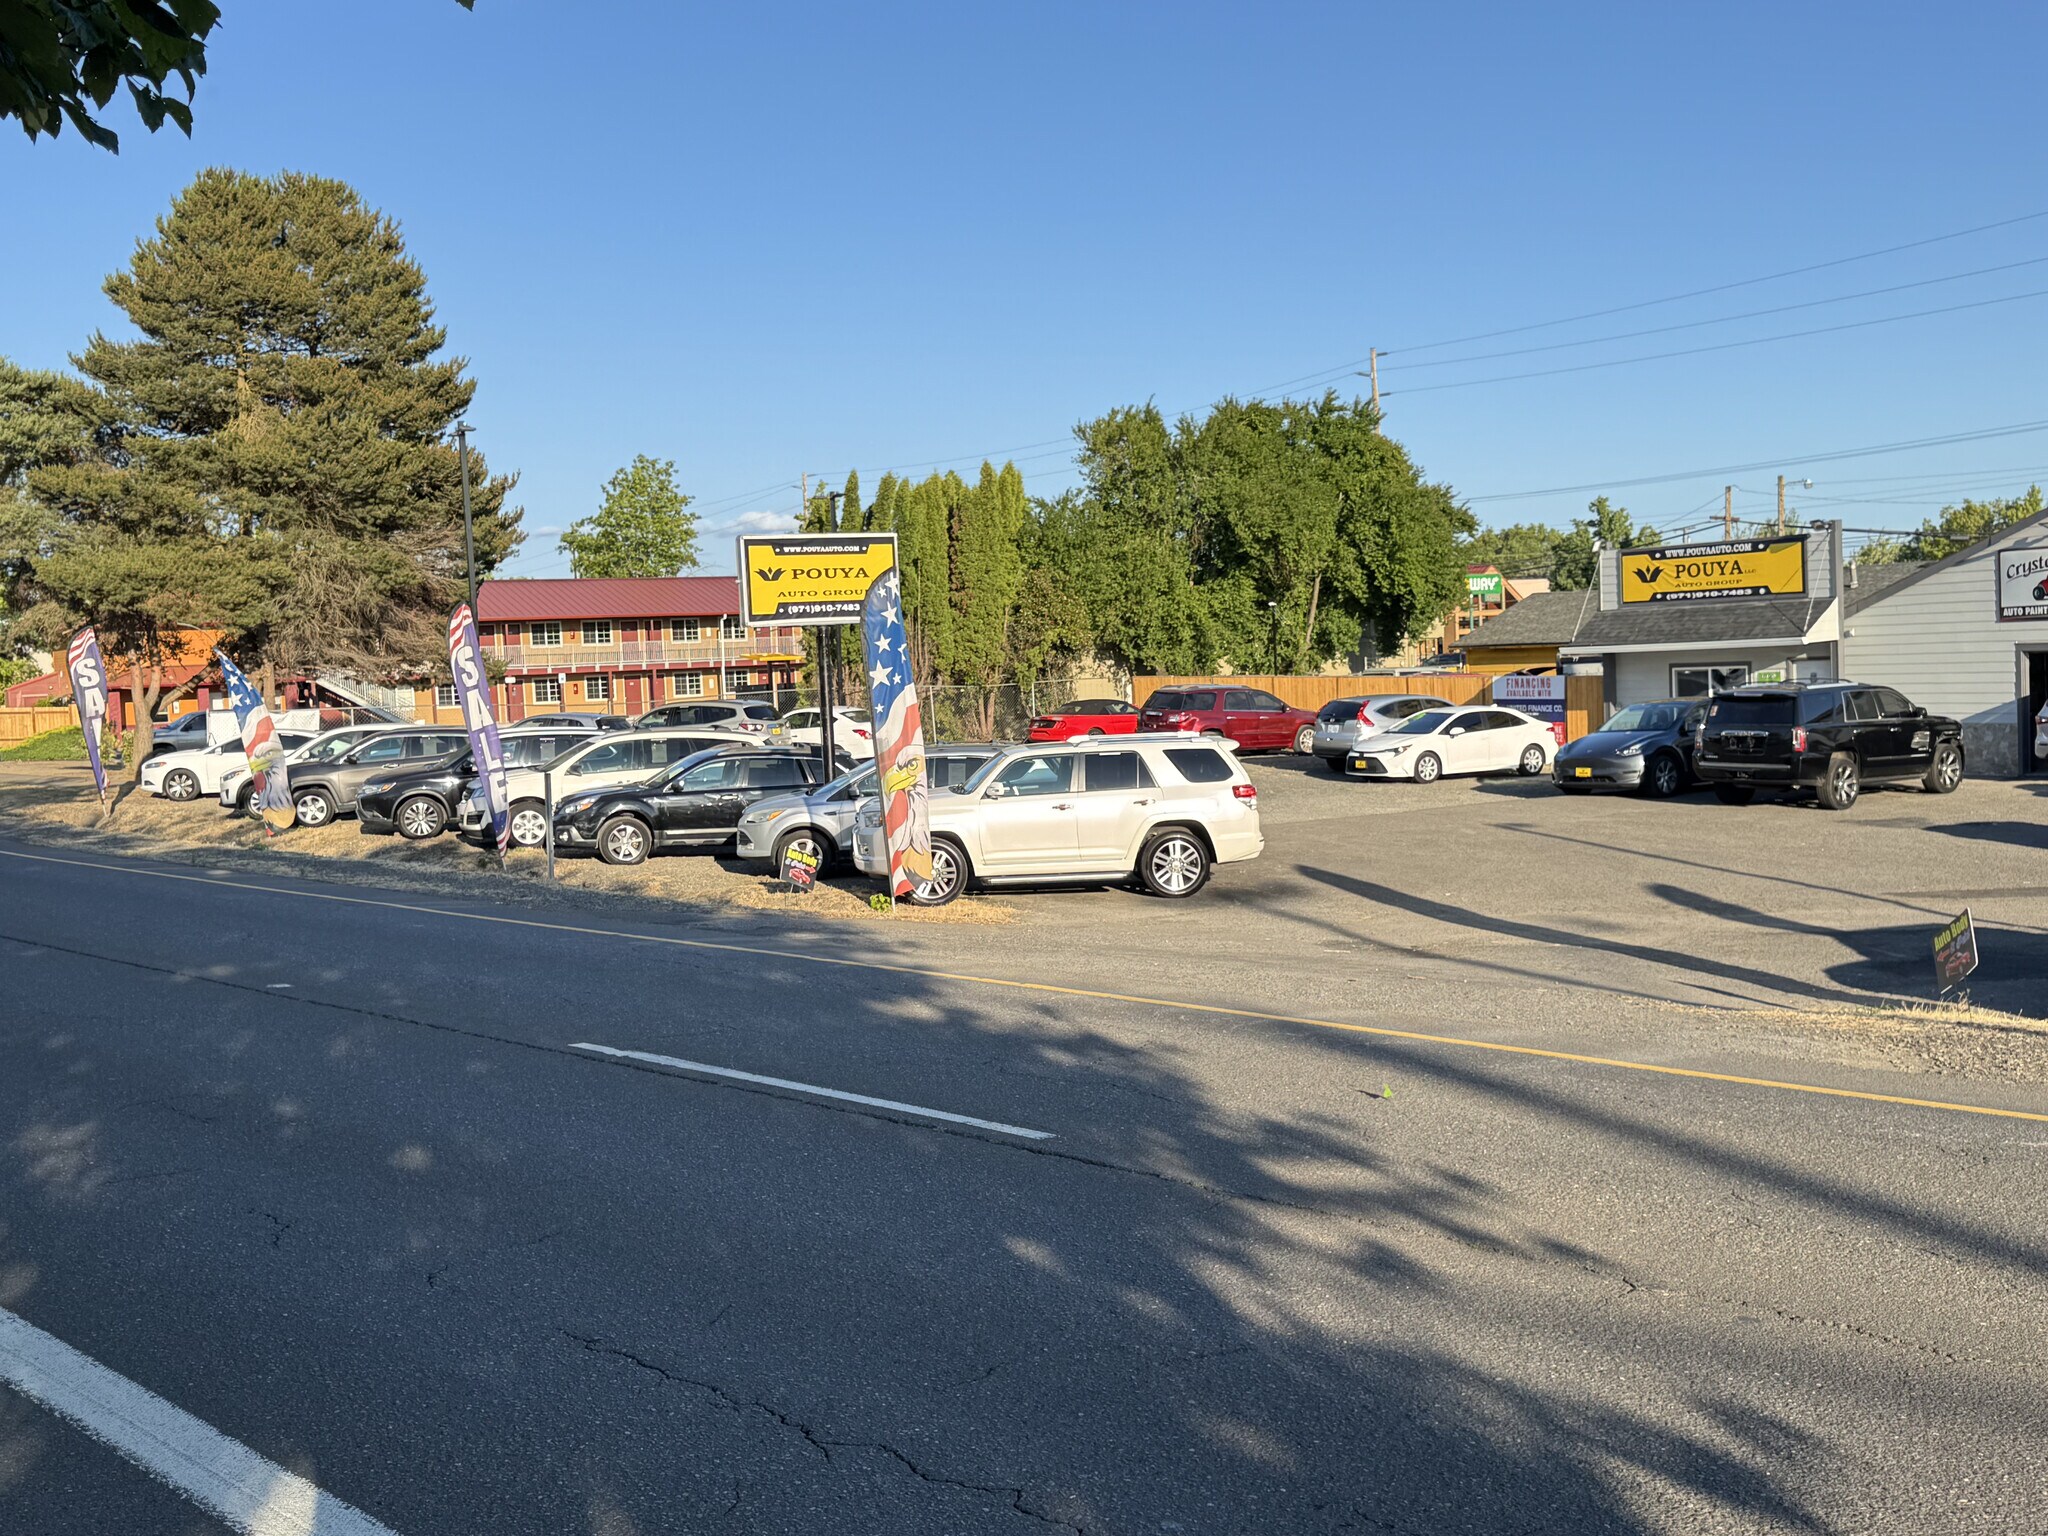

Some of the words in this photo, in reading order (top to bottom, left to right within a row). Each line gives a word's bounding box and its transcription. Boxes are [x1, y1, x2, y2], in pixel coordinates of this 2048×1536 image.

[783, 545, 860, 554] WWW.POUYAAUTO.COM
[1664, 543, 1753, 559] WWW.POUYAAUTO.COM
[791, 566, 870, 580] POUYA
[1674, 560, 1745, 580] POUYA
[1465, 576, 1500, 591] WAY
[1674, 581, 1703, 589] AUTO
[1705, 579, 1744, 587] GROUP
[777, 590, 818, 598] AUTO
[1665, 589, 1753, 602] (971)910-7483
[787, 603, 861, 615] (971)910-7483
[2003, 607, 2023, 617] AUTO
[2025, 606, 2048, 616] PAINT
[1506, 677, 1552, 689] FINANCING
[1506, 689, 1536, 698] AVAILABLE
[1537, 689, 1552, 697] WITH
[1527, 704, 1553, 713] FINANCE
[1553, 704, 1564, 713] CO.
[455, 644, 509, 815] SALE
[786, 848, 803, 862] Auto
[802, 853, 818, 868] Body
[1933, 930, 1951, 952] Auto
[1950, 914, 1969, 938] Body
